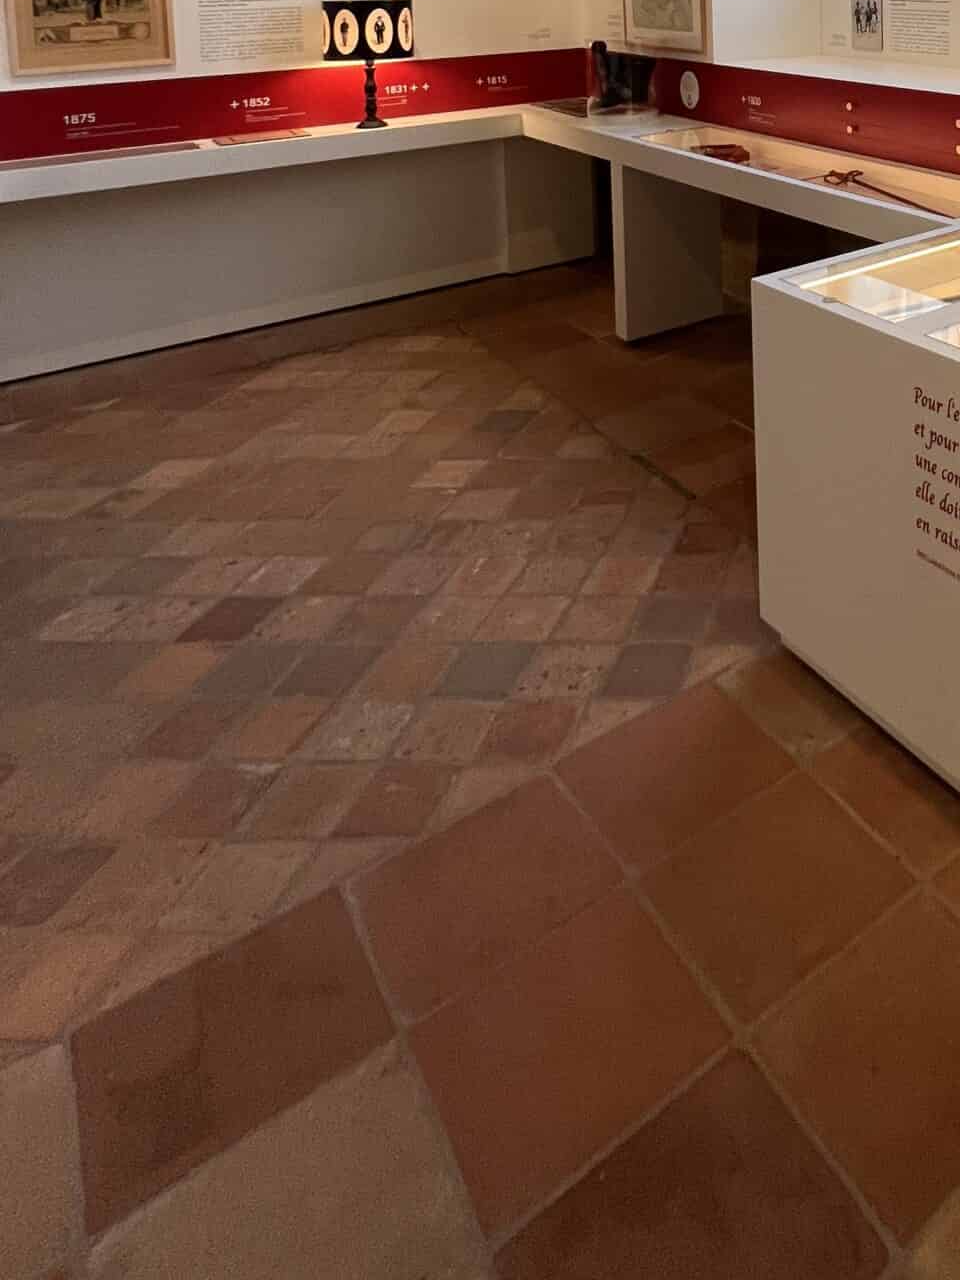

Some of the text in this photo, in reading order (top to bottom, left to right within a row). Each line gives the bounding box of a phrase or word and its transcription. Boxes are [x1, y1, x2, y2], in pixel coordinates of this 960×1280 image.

[913, 386, 943, 414] Pour
[914, 423, 925, 438] et
[925, 429, 960, 453] pour
[915, 453, 938, 475] une
[915, 480, 936, 505] elle
[915, 517, 930, 534] en
